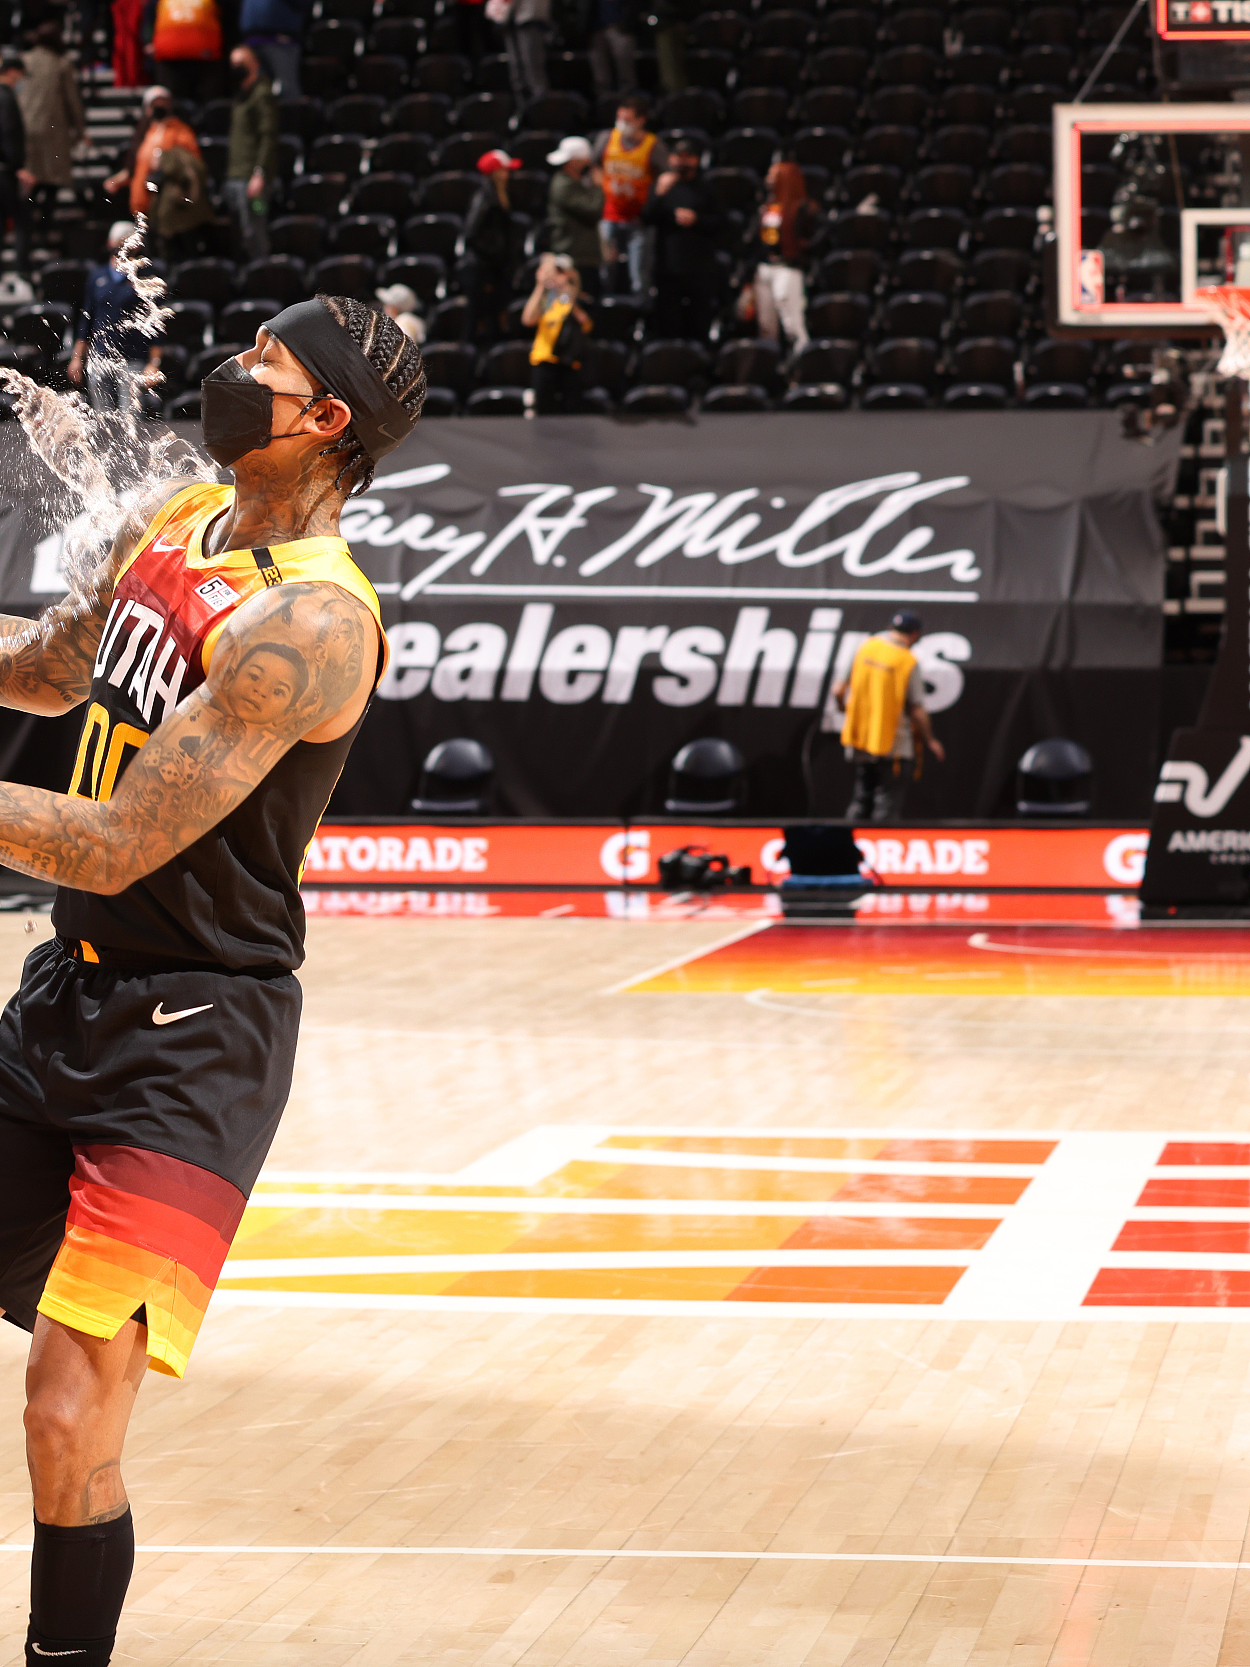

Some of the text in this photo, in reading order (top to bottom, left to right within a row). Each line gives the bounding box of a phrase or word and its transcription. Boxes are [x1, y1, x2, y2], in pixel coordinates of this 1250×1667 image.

[578, 471, 981, 582] Miller
[199, 579, 223, 595] 5
[92, 598, 188, 726] UTAH
[374, 602, 972, 733] ealershis
[304, 835, 490, 873] ATORADE
[599, 829, 651, 881] G
[759, 837, 990, 875] GORADE
[1167, 830, 1250, 853] AMERI
